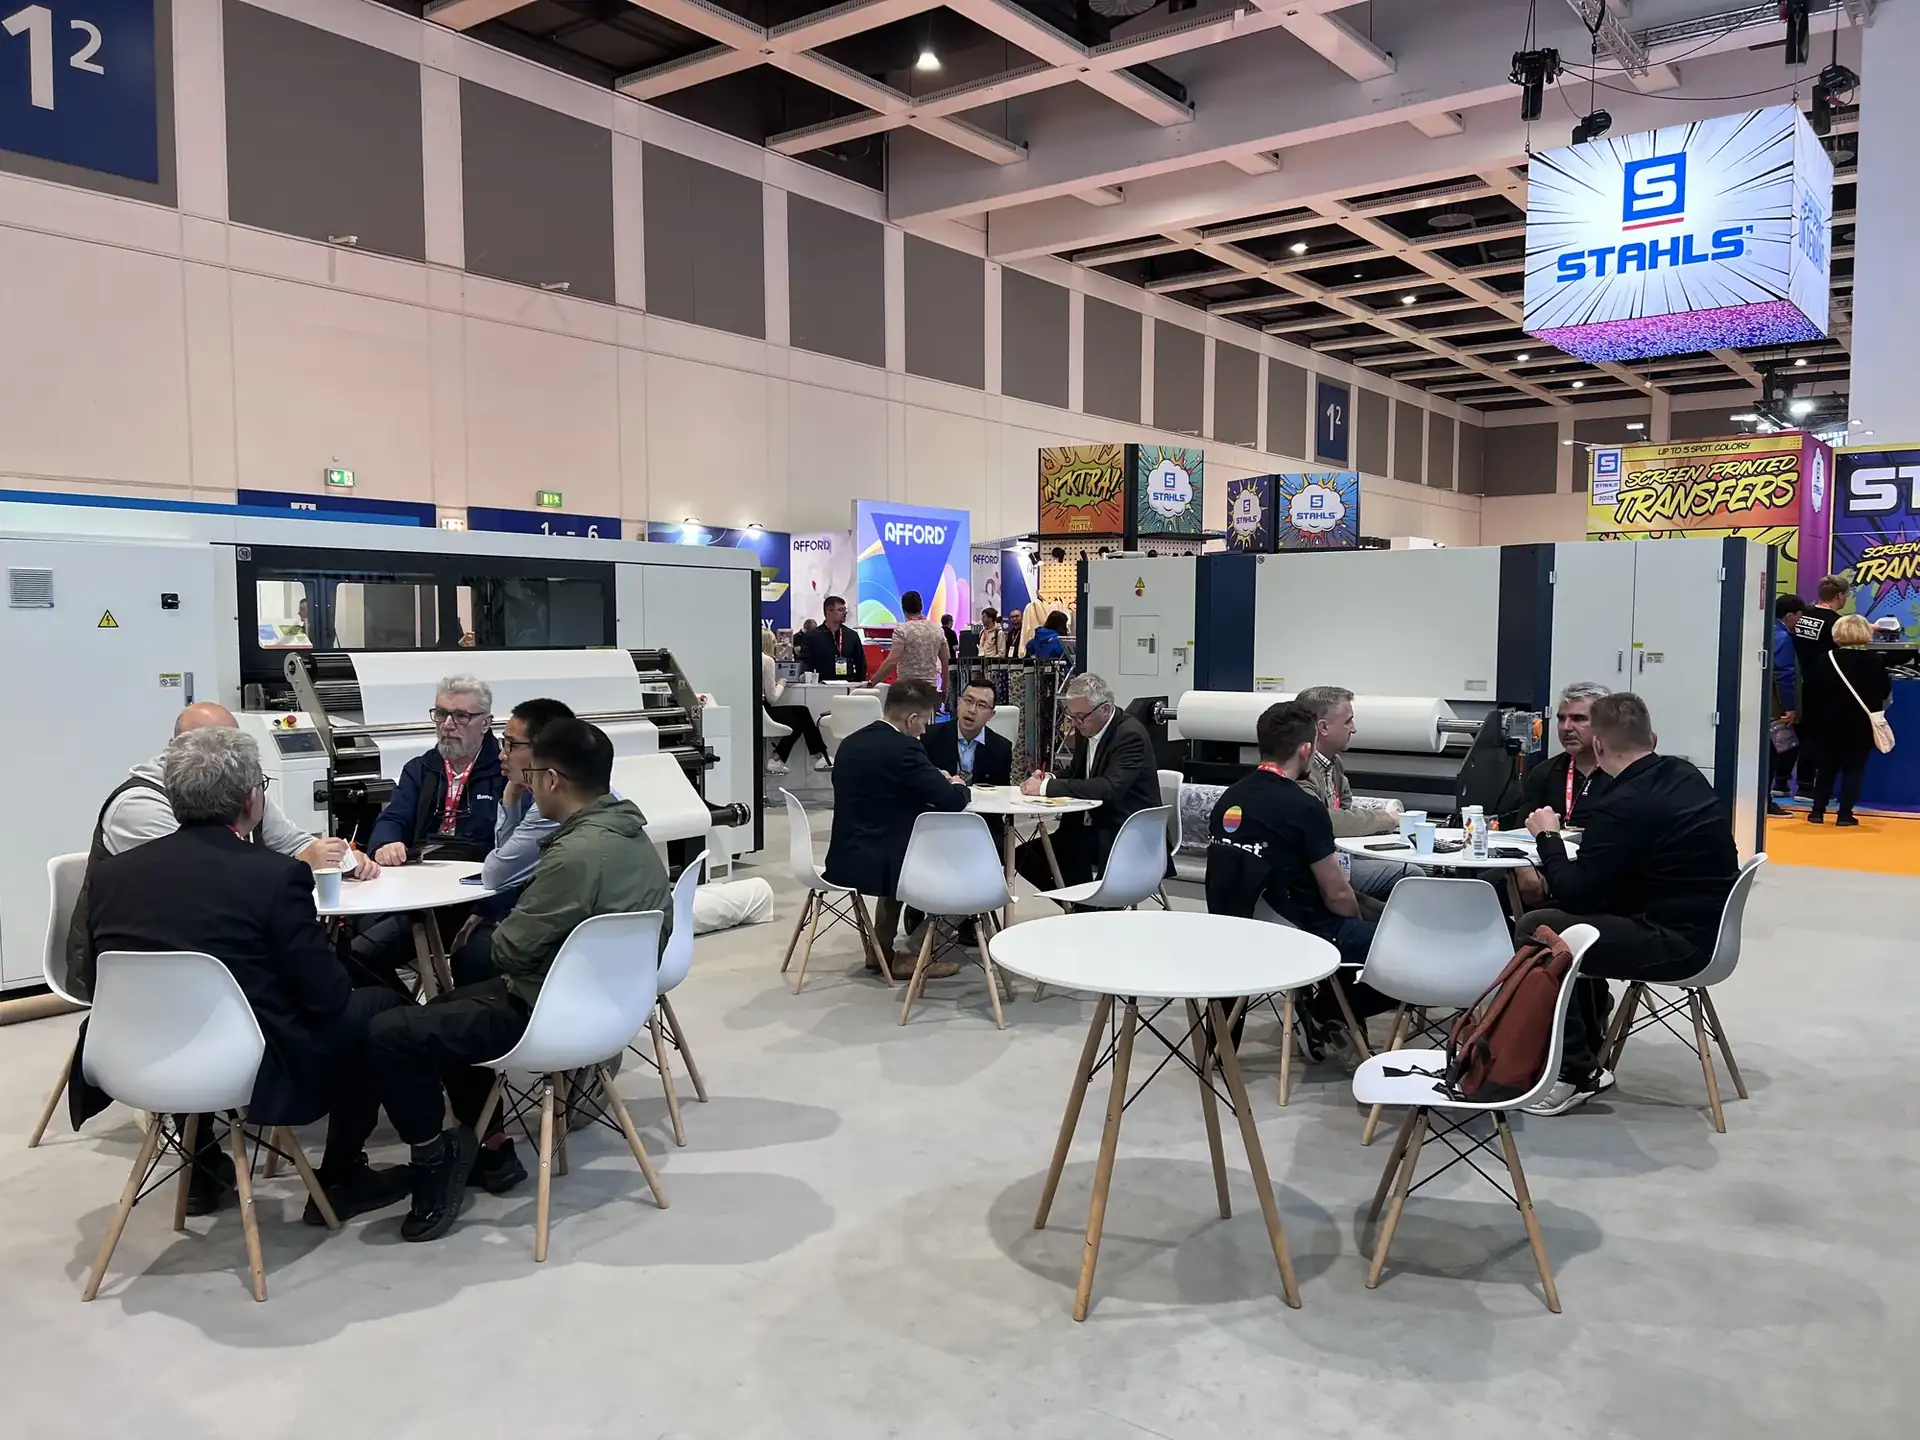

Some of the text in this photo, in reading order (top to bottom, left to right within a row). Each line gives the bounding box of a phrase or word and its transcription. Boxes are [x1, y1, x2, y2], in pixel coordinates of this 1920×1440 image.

[1657, 448, 1669, 456] UP
[1670, 447, 1682, 455] TO
[1682, 446, 1690, 454] 5
[1690, 444, 1714, 453] SPOT
[1625, 464, 1706, 488] SCREEN
[1706, 454, 1798, 480] PRINTED
[1615, 472, 1800, 524] TRANSFERS
[884, 521, 946, 546] AFFORD
[793, 540, 831, 553] AFFORD
[1863, 542, 1920, 558] SCREEN
[972, 554, 999, 565] AFFORD
